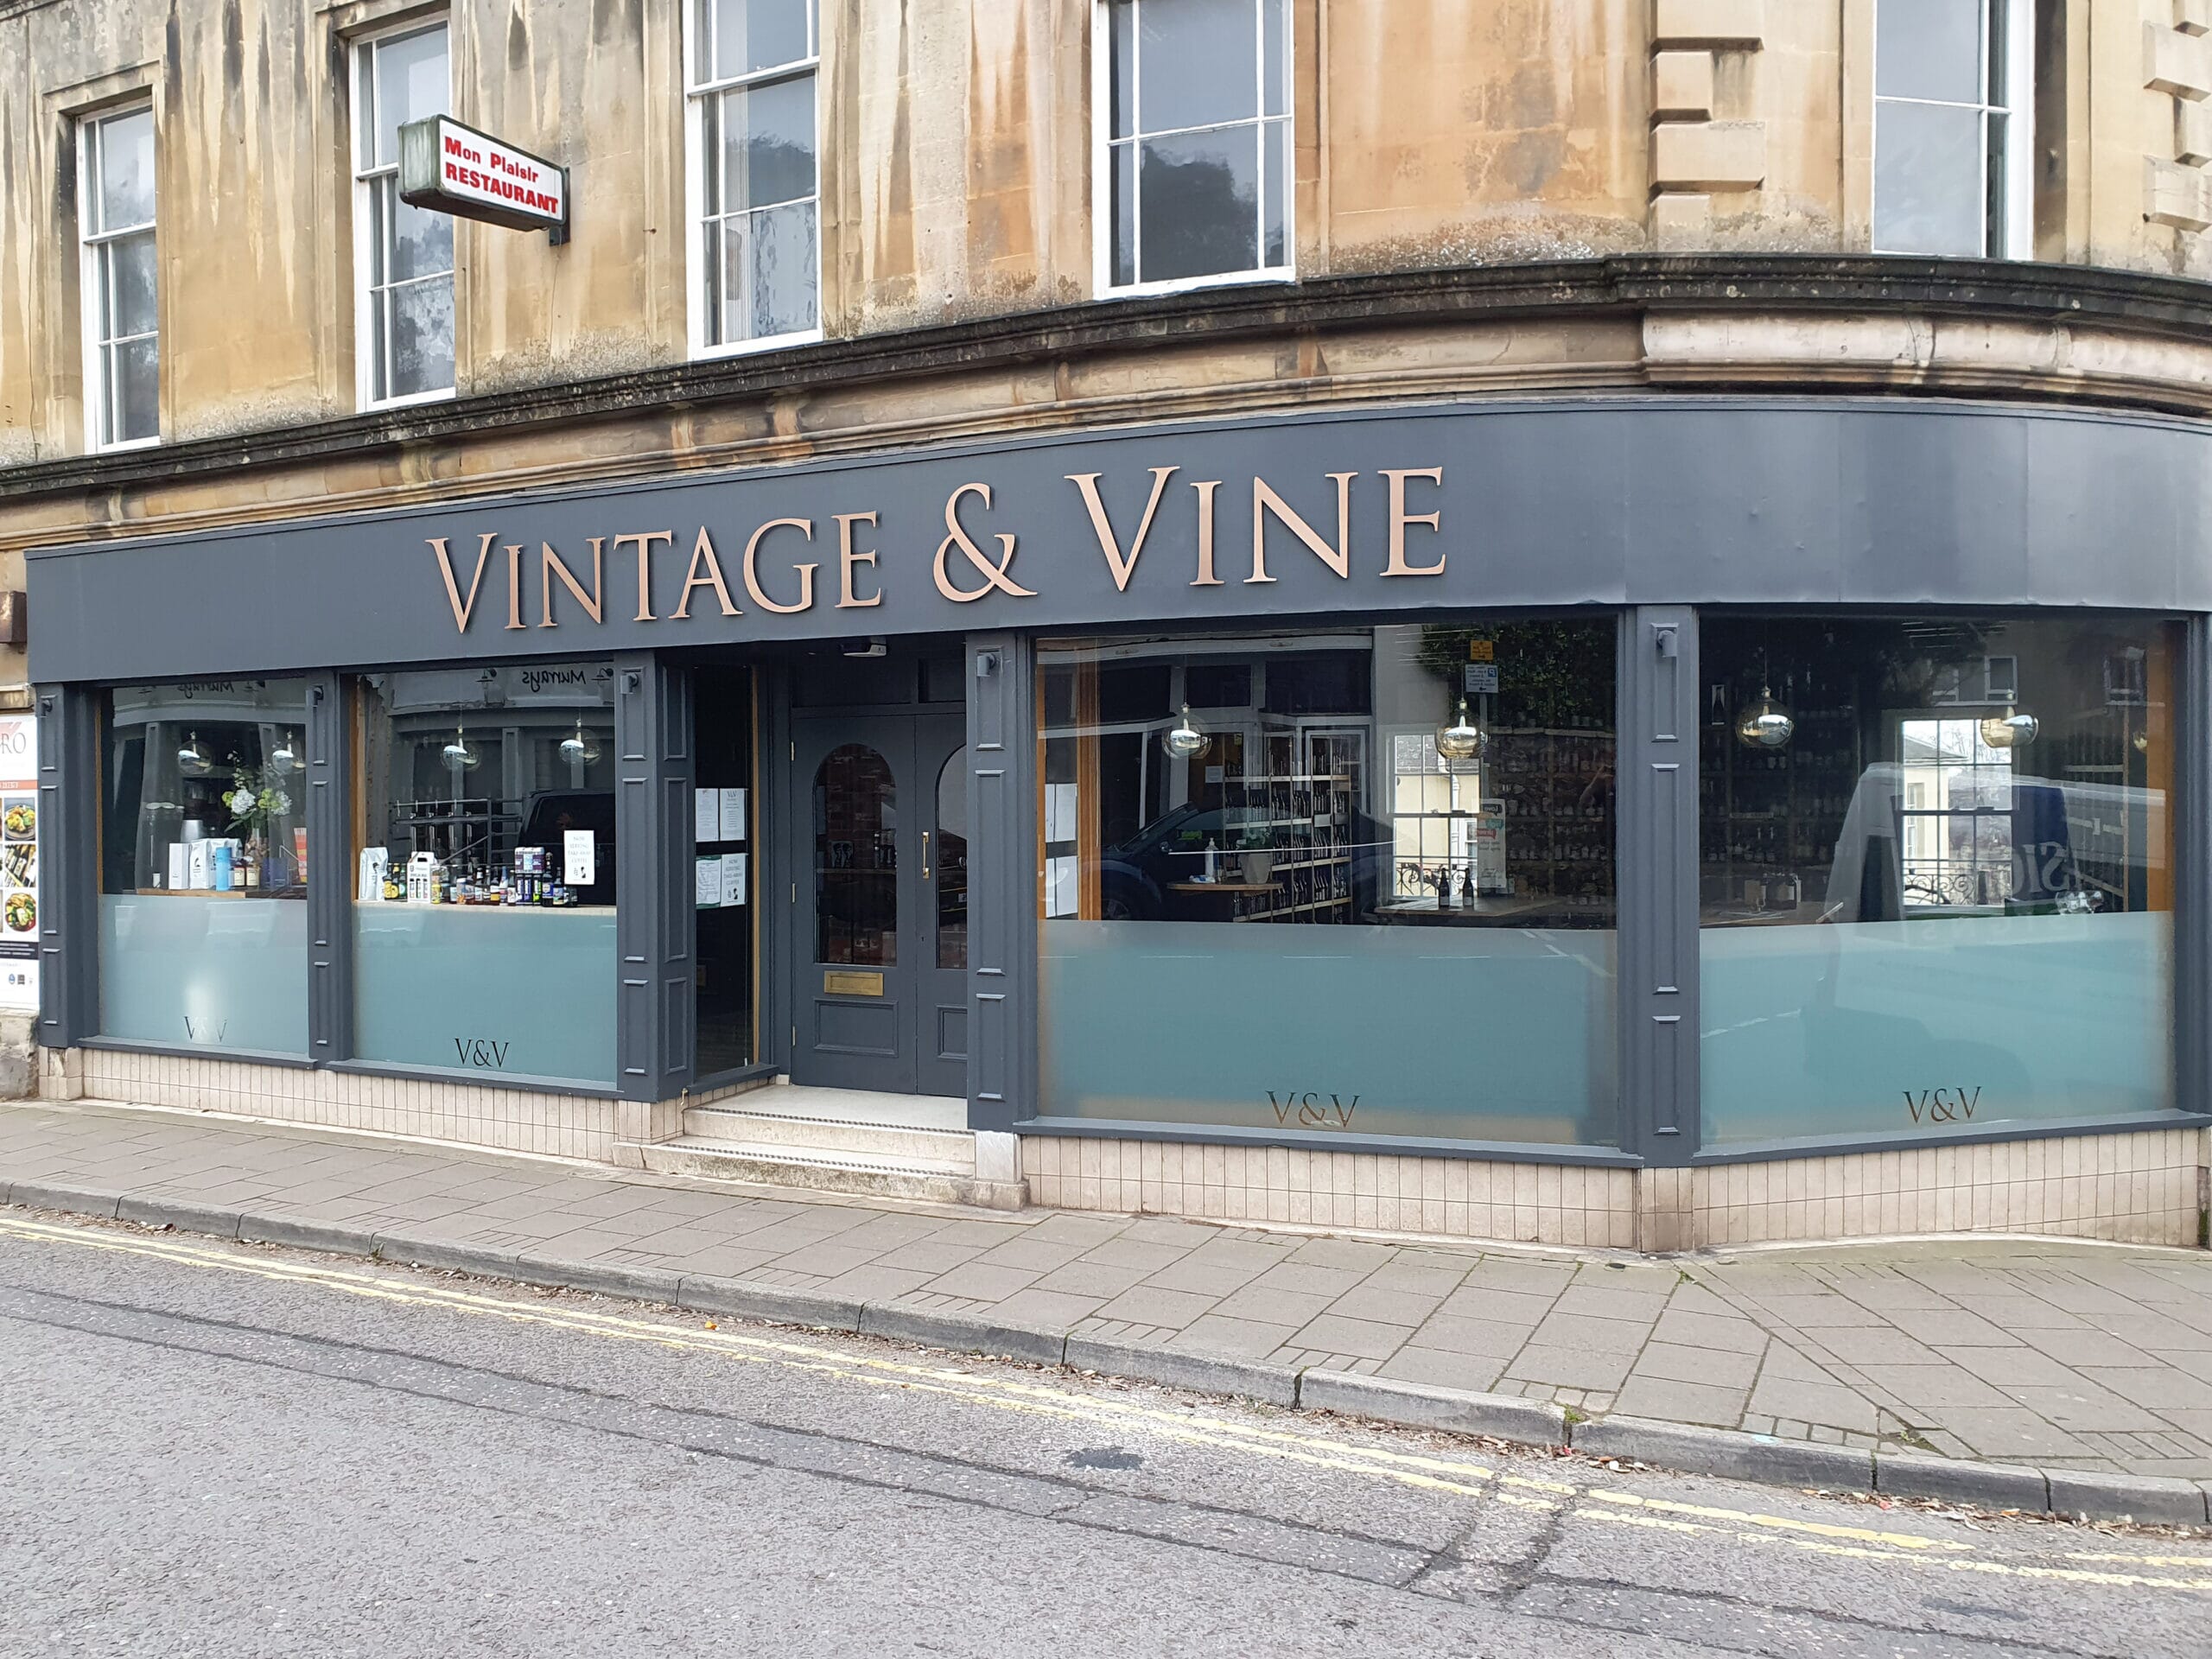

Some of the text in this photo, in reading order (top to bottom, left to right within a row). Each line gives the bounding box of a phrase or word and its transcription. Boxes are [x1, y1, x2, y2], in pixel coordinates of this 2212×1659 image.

[444, 136, 481, 164] Mon
[445, 162, 559, 214] RESTAURANT
[424, 465, 1446, 635] VINTAGE & VINE
[184, 1015, 227, 1043] VV
[454, 1038, 510, 1068] V&V
[1265, 1090, 1361, 1128] V&V
[1902, 1085, 1982, 1124] V&V
